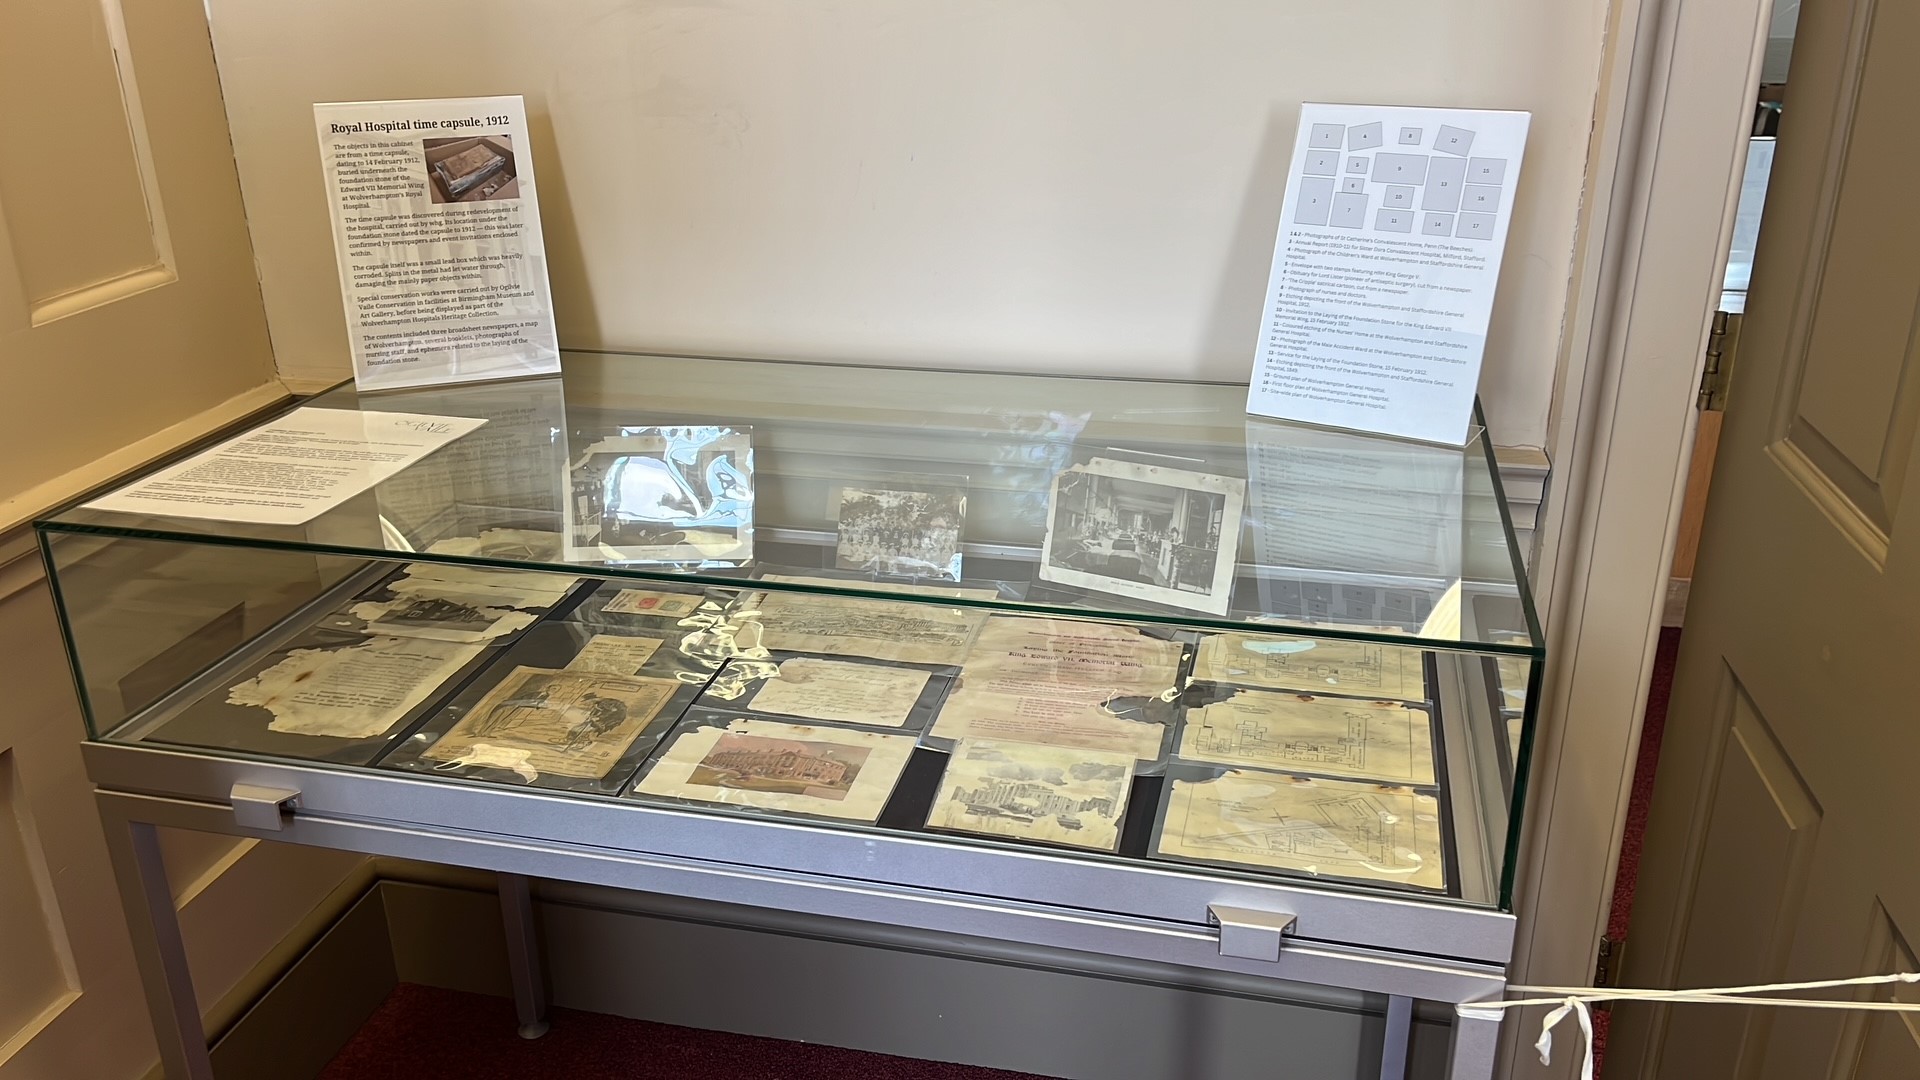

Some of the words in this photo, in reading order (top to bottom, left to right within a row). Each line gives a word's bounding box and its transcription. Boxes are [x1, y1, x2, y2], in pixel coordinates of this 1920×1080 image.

[331, 122, 362, 134] Royal
[365, 120, 410, 133] Hospital
[413, 118, 437, 128] time
[440, 116, 483, 130] capsule,
[486, 115, 508, 125] 1912
[346, 142, 369, 150] objects
[335, 160, 356, 168] dating
[373, 158, 403, 166] February
[407, 182, 425, 190] Wing
[349, 192, 404, 202] Wolverhampton's
[405, 190, 423, 199] Royal
[373, 214, 397, 222] capsule
[444, 210, 465, 218] during
[466, 207, 511, 216] redevelopment
[429, 227, 453, 236] capsule
[365, 263, 389, 271] capsule
[501, 253, 523, 262] heavily
[384, 270, 402, 278] Splits
[354, 280, 386, 289] damaging
[397, 277, 419, 286] mainly
[439, 274, 461, 283] objects
[356, 294, 379, 303] Special
[380, 291, 420, 299] conservation
[499, 284, 520, 292] Ogilvie
[374, 300, 416, 308] Conservation
[458, 294, 496, 303] Birmingham
